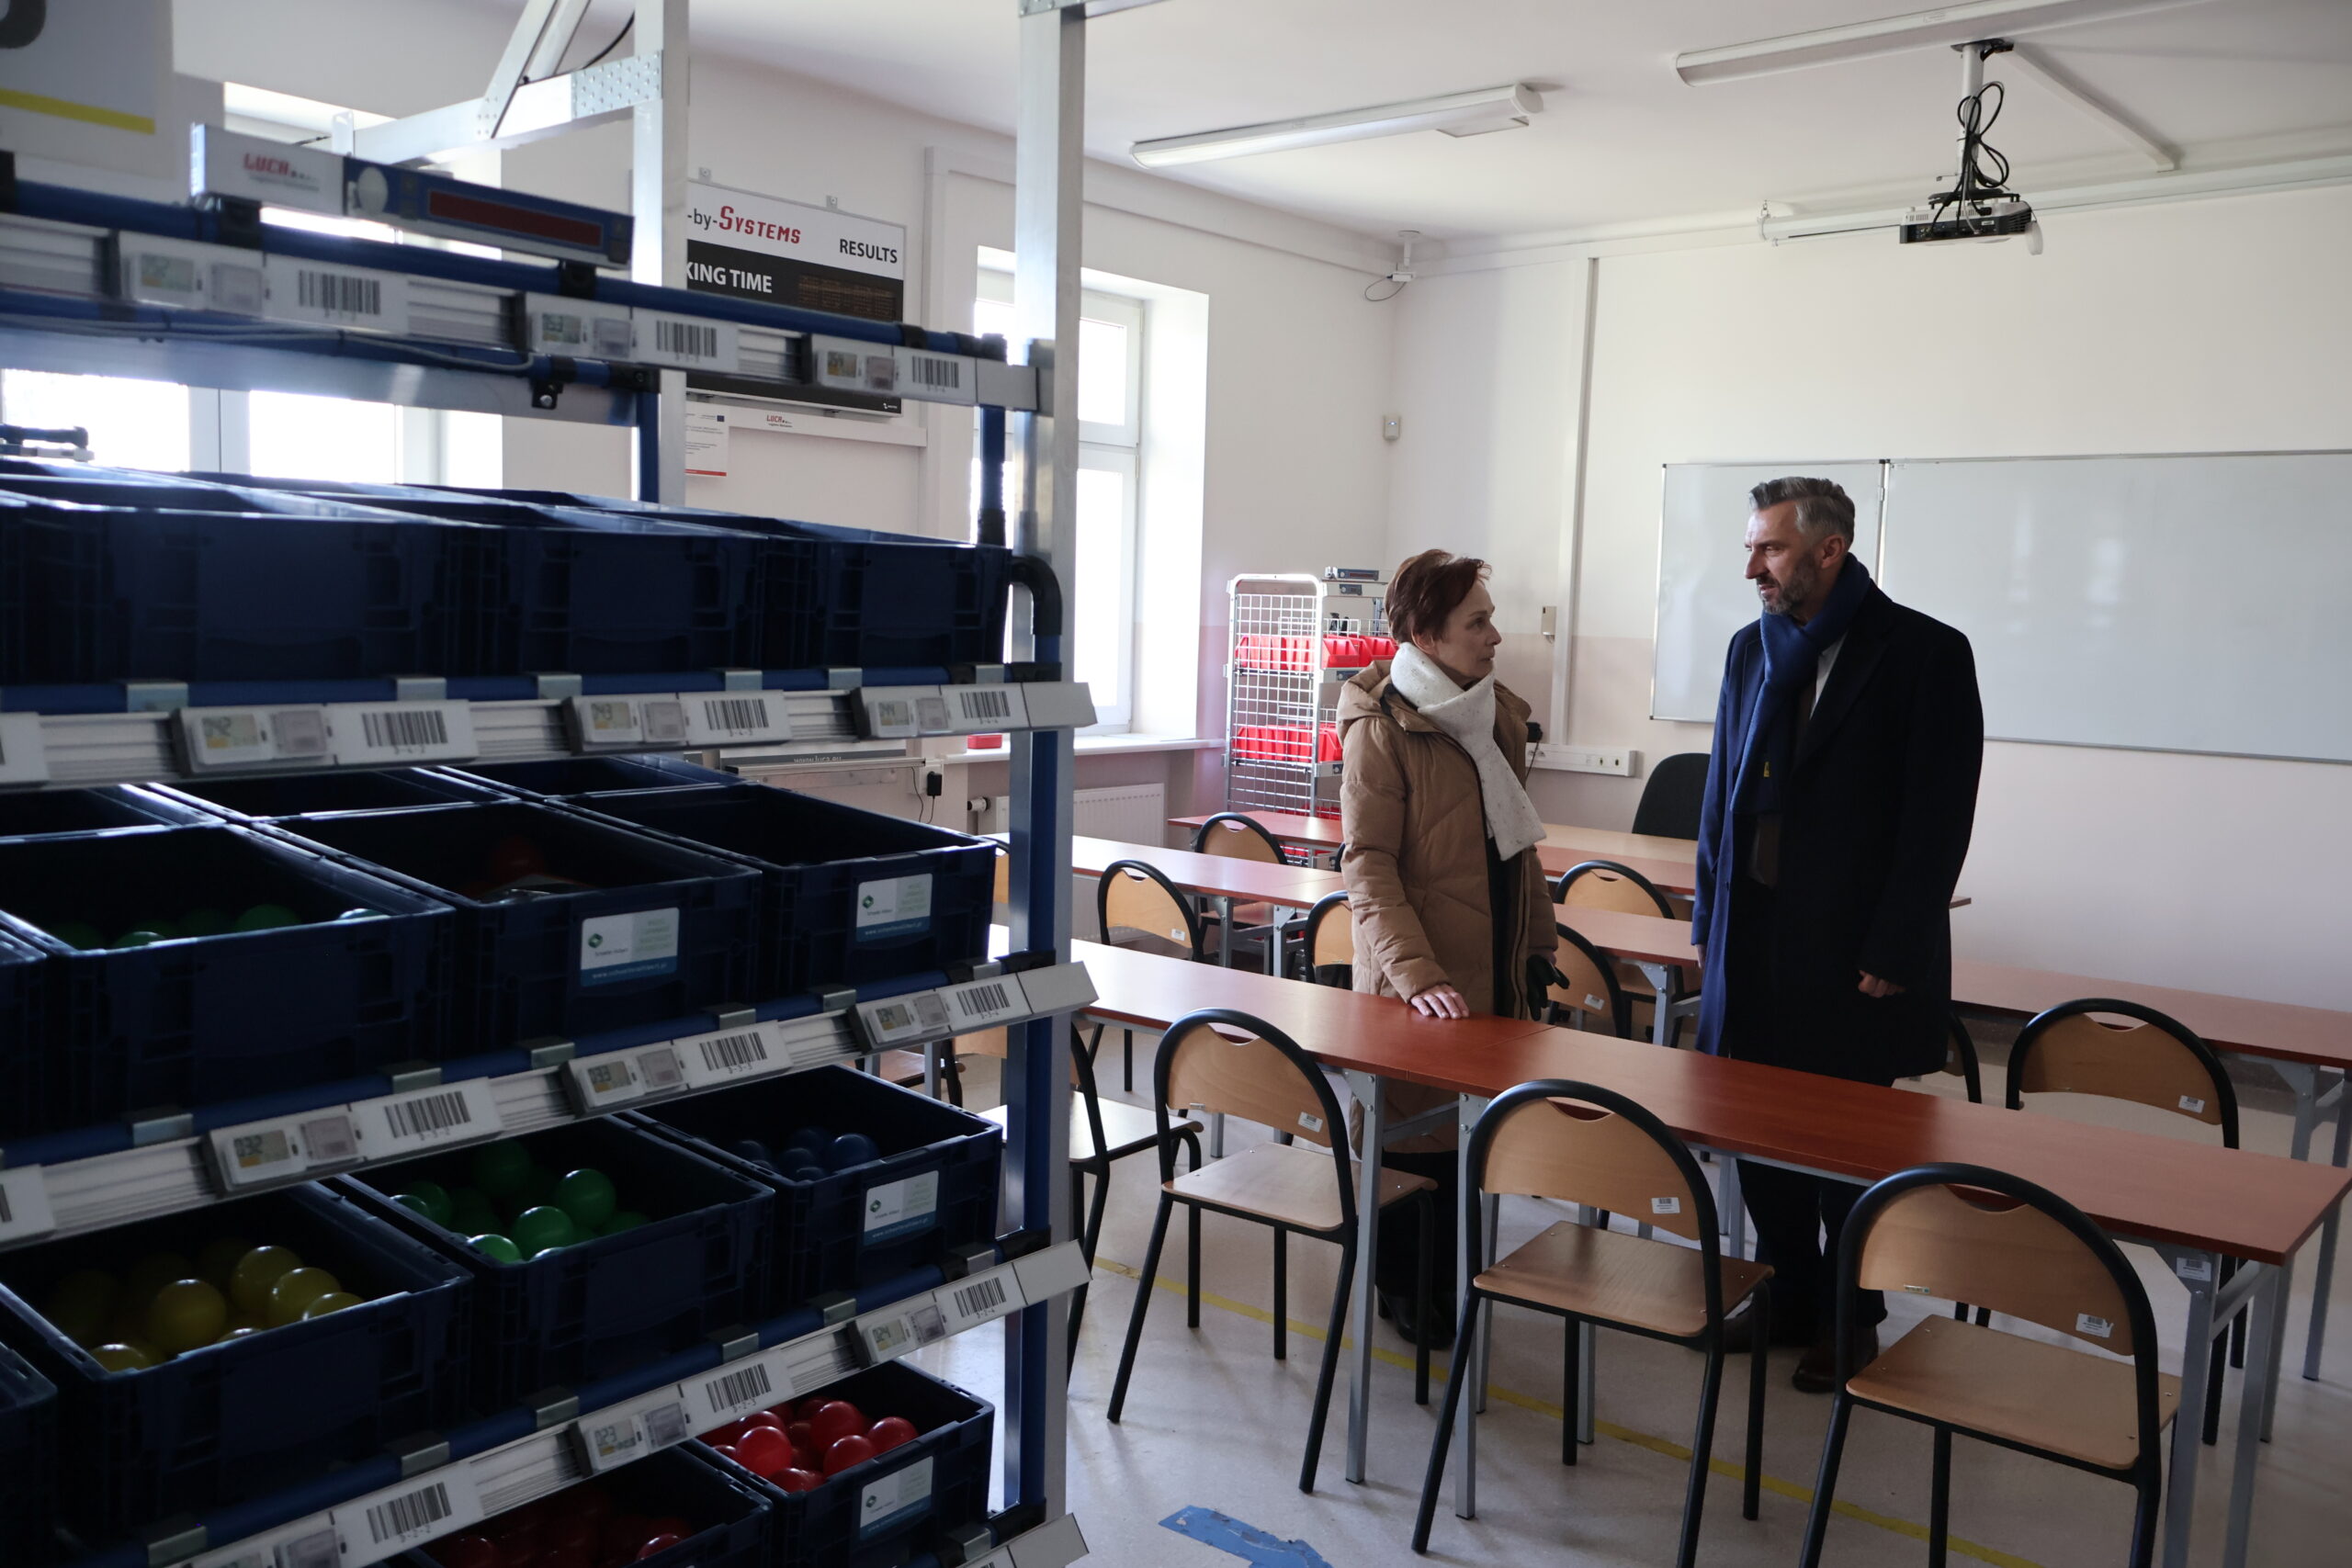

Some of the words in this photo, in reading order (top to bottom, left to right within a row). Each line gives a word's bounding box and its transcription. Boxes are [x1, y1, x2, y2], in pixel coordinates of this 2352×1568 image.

[840, 239, 898, 264] RESULTS
[729, 269, 773, 293] TIME
[594, 1426, 617, 1447] 023
